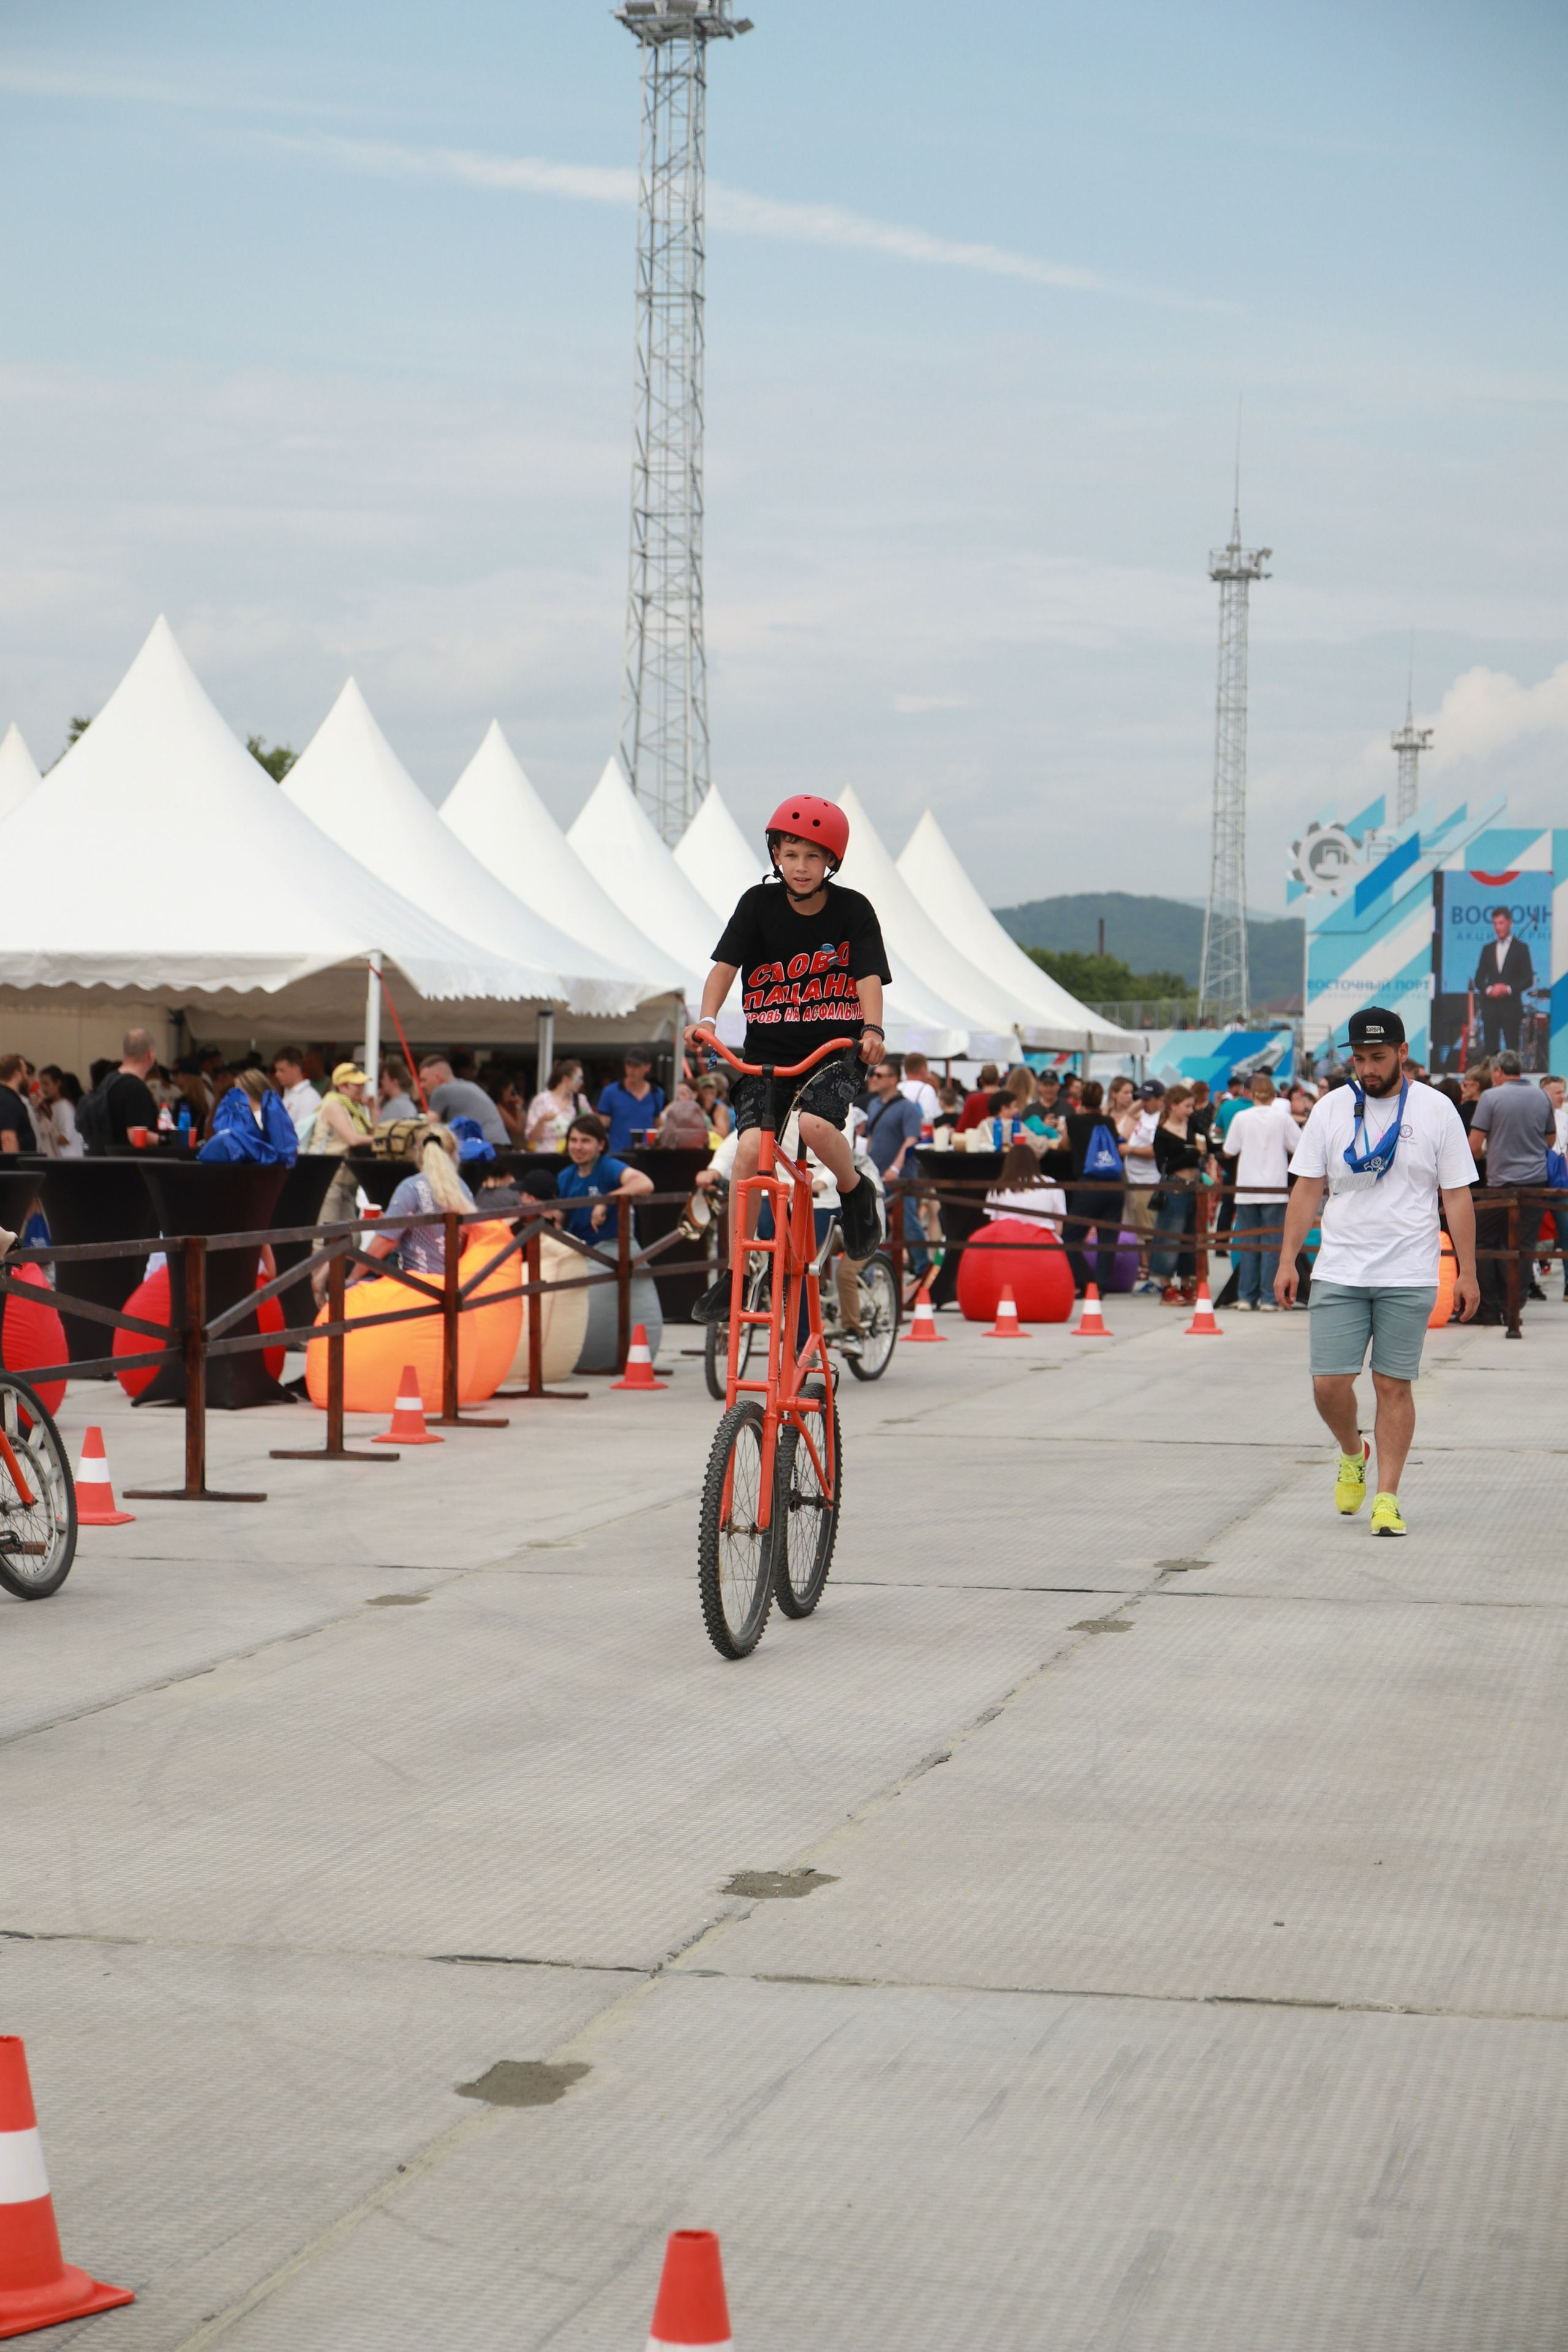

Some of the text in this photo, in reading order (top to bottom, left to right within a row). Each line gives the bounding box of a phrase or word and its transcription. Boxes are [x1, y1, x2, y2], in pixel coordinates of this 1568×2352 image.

[1452, 905, 1552, 925] ВОСОЧН
[748, 941, 850, 988] СЛОВО
[743, 973, 859, 1011] ПАЦАНА
[1396, 979, 1430, 990] ПОРТ
[784, 1006, 800, 1022] НА
